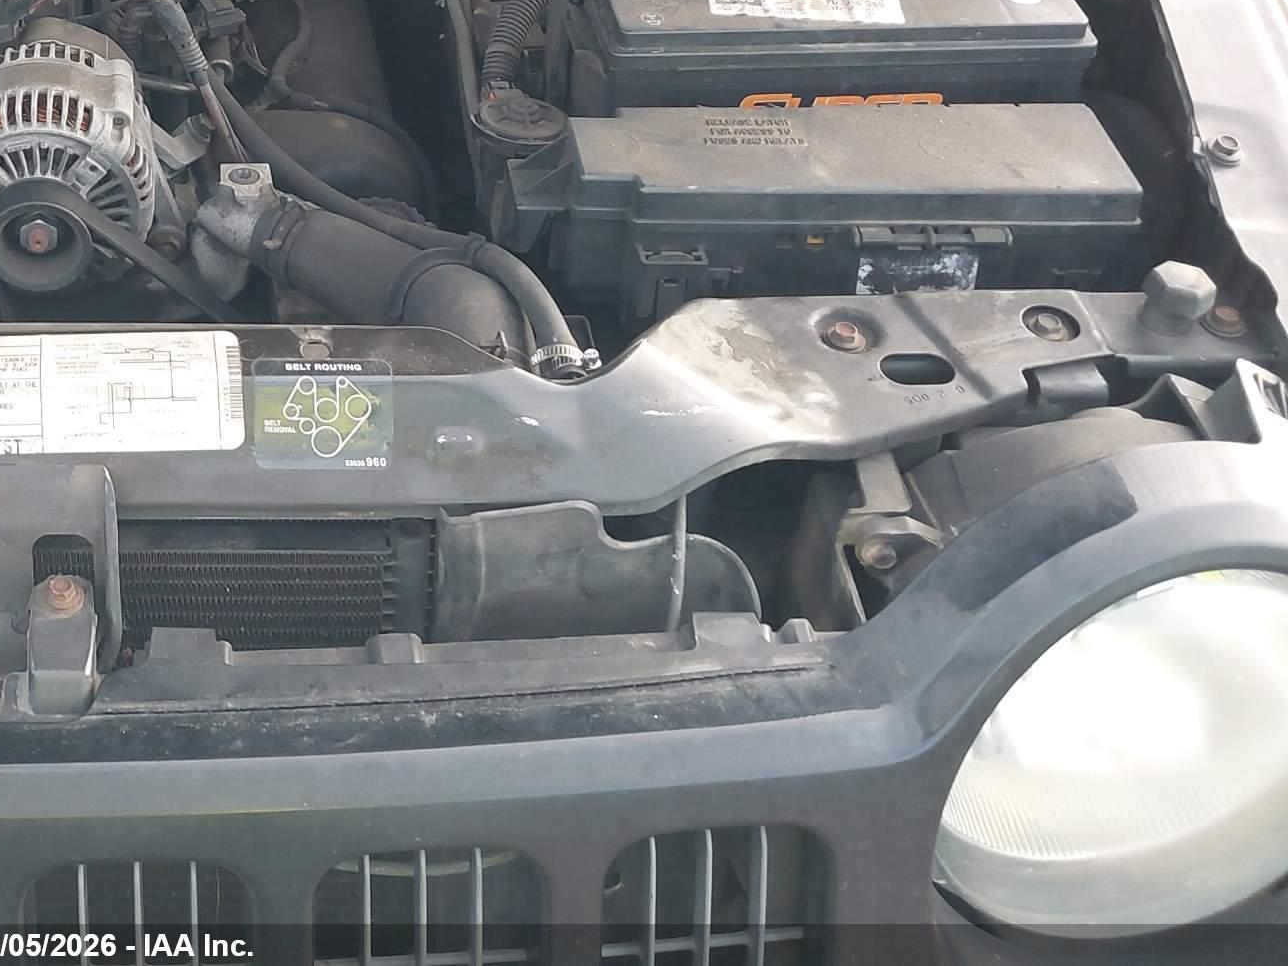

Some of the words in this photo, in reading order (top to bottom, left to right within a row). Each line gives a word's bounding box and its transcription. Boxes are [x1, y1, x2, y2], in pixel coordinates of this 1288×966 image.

[285, 363, 312, 371] BELT
[314, 363, 363, 371] ROUTING
[264, 426, 297, 434] REMOVAL
